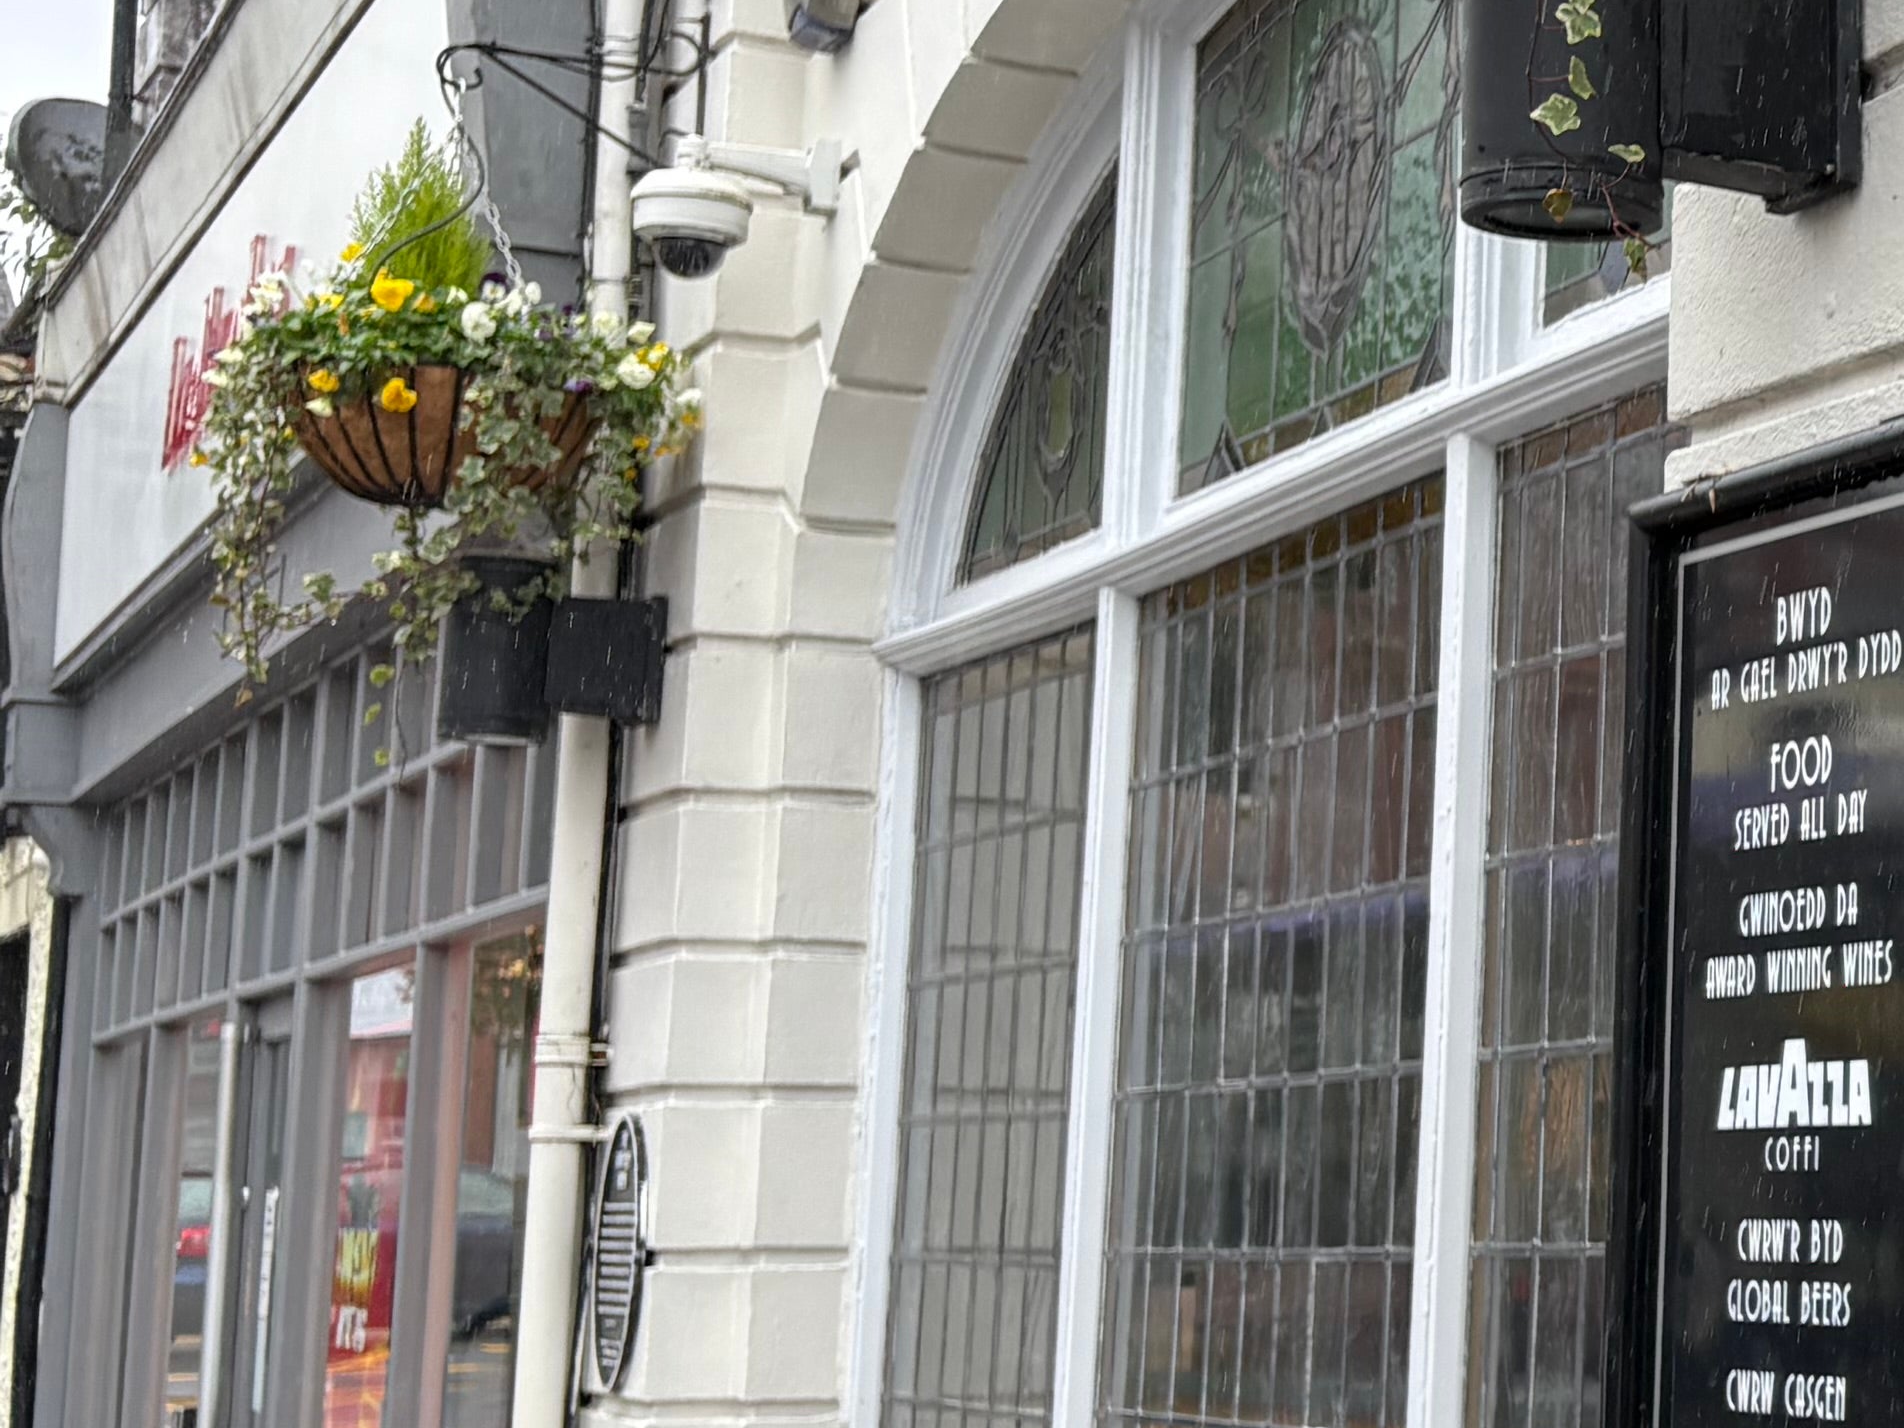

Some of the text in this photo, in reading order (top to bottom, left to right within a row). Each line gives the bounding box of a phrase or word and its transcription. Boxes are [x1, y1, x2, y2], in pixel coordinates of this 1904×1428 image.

[1776, 586, 1833, 647] BWYD
[1710, 629, 1902, 711] AR GAEL DRWY'R DYDD
[1770, 734, 1833, 792] FOOD
[1734, 789, 1868, 851] SERVED ALL DAY
[1739, 882, 1858, 937] GWINOEDD DA
[1705, 939, 1893, 999] AWARD WINNING WINES
[1716, 1038, 1872, 1130] LAVAZZA
[1764, 1135, 1820, 1172] COFFI
[1737, 1218, 1844, 1264] CWRW'R BYD
[1727, 1278, 1852, 1327] GLOBAL BEERS
[1726, 1369, 1847, 1421] CWRW CASGEN
